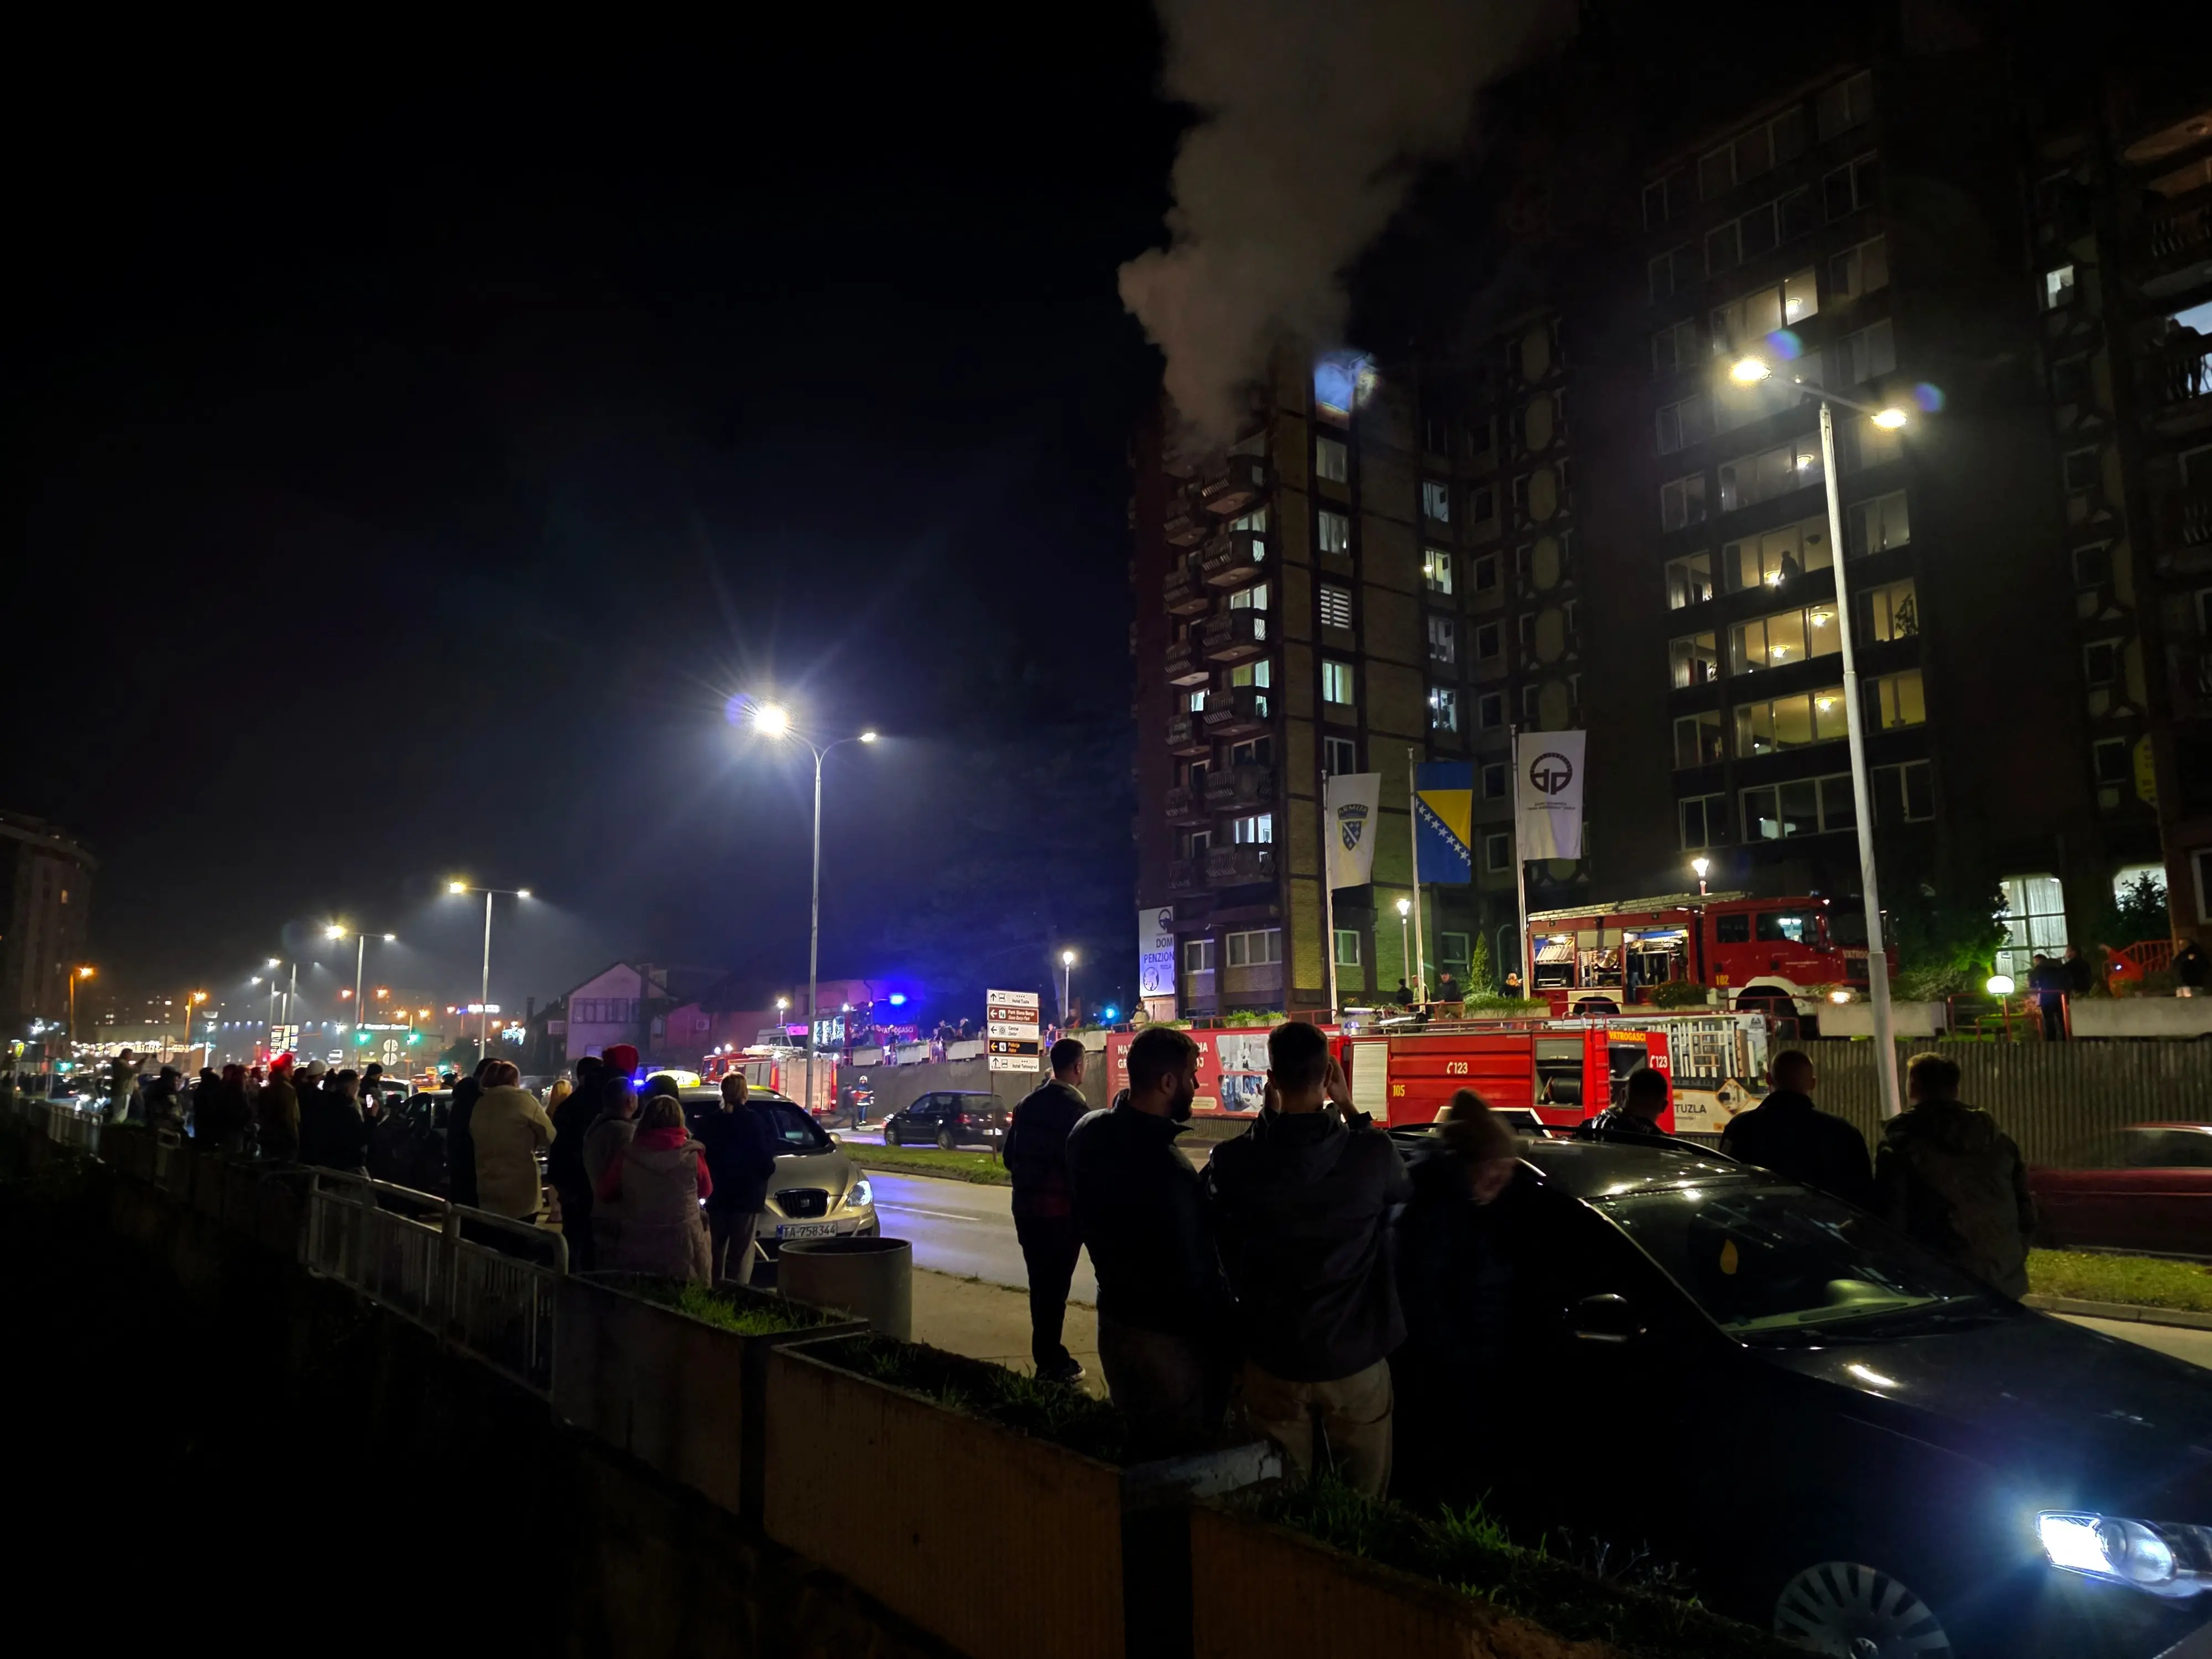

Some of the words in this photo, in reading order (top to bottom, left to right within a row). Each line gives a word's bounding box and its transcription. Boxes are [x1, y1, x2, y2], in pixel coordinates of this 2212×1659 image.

[1156, 936, 1173, 948] DOM
[1144, 951, 1175, 964] PENZION
[1715, 975, 1730, 985] 102
[1609, 1031, 1646, 1042] VATROGASCI
[1655, 1055, 1668, 1068] 123
[1454, 1062, 1468, 1074] 123
[1393, 1084, 1406, 1097] 105
[1674, 1104, 1707, 1114] TUZLA
[783, 1224, 835, 1238] TA-758344
